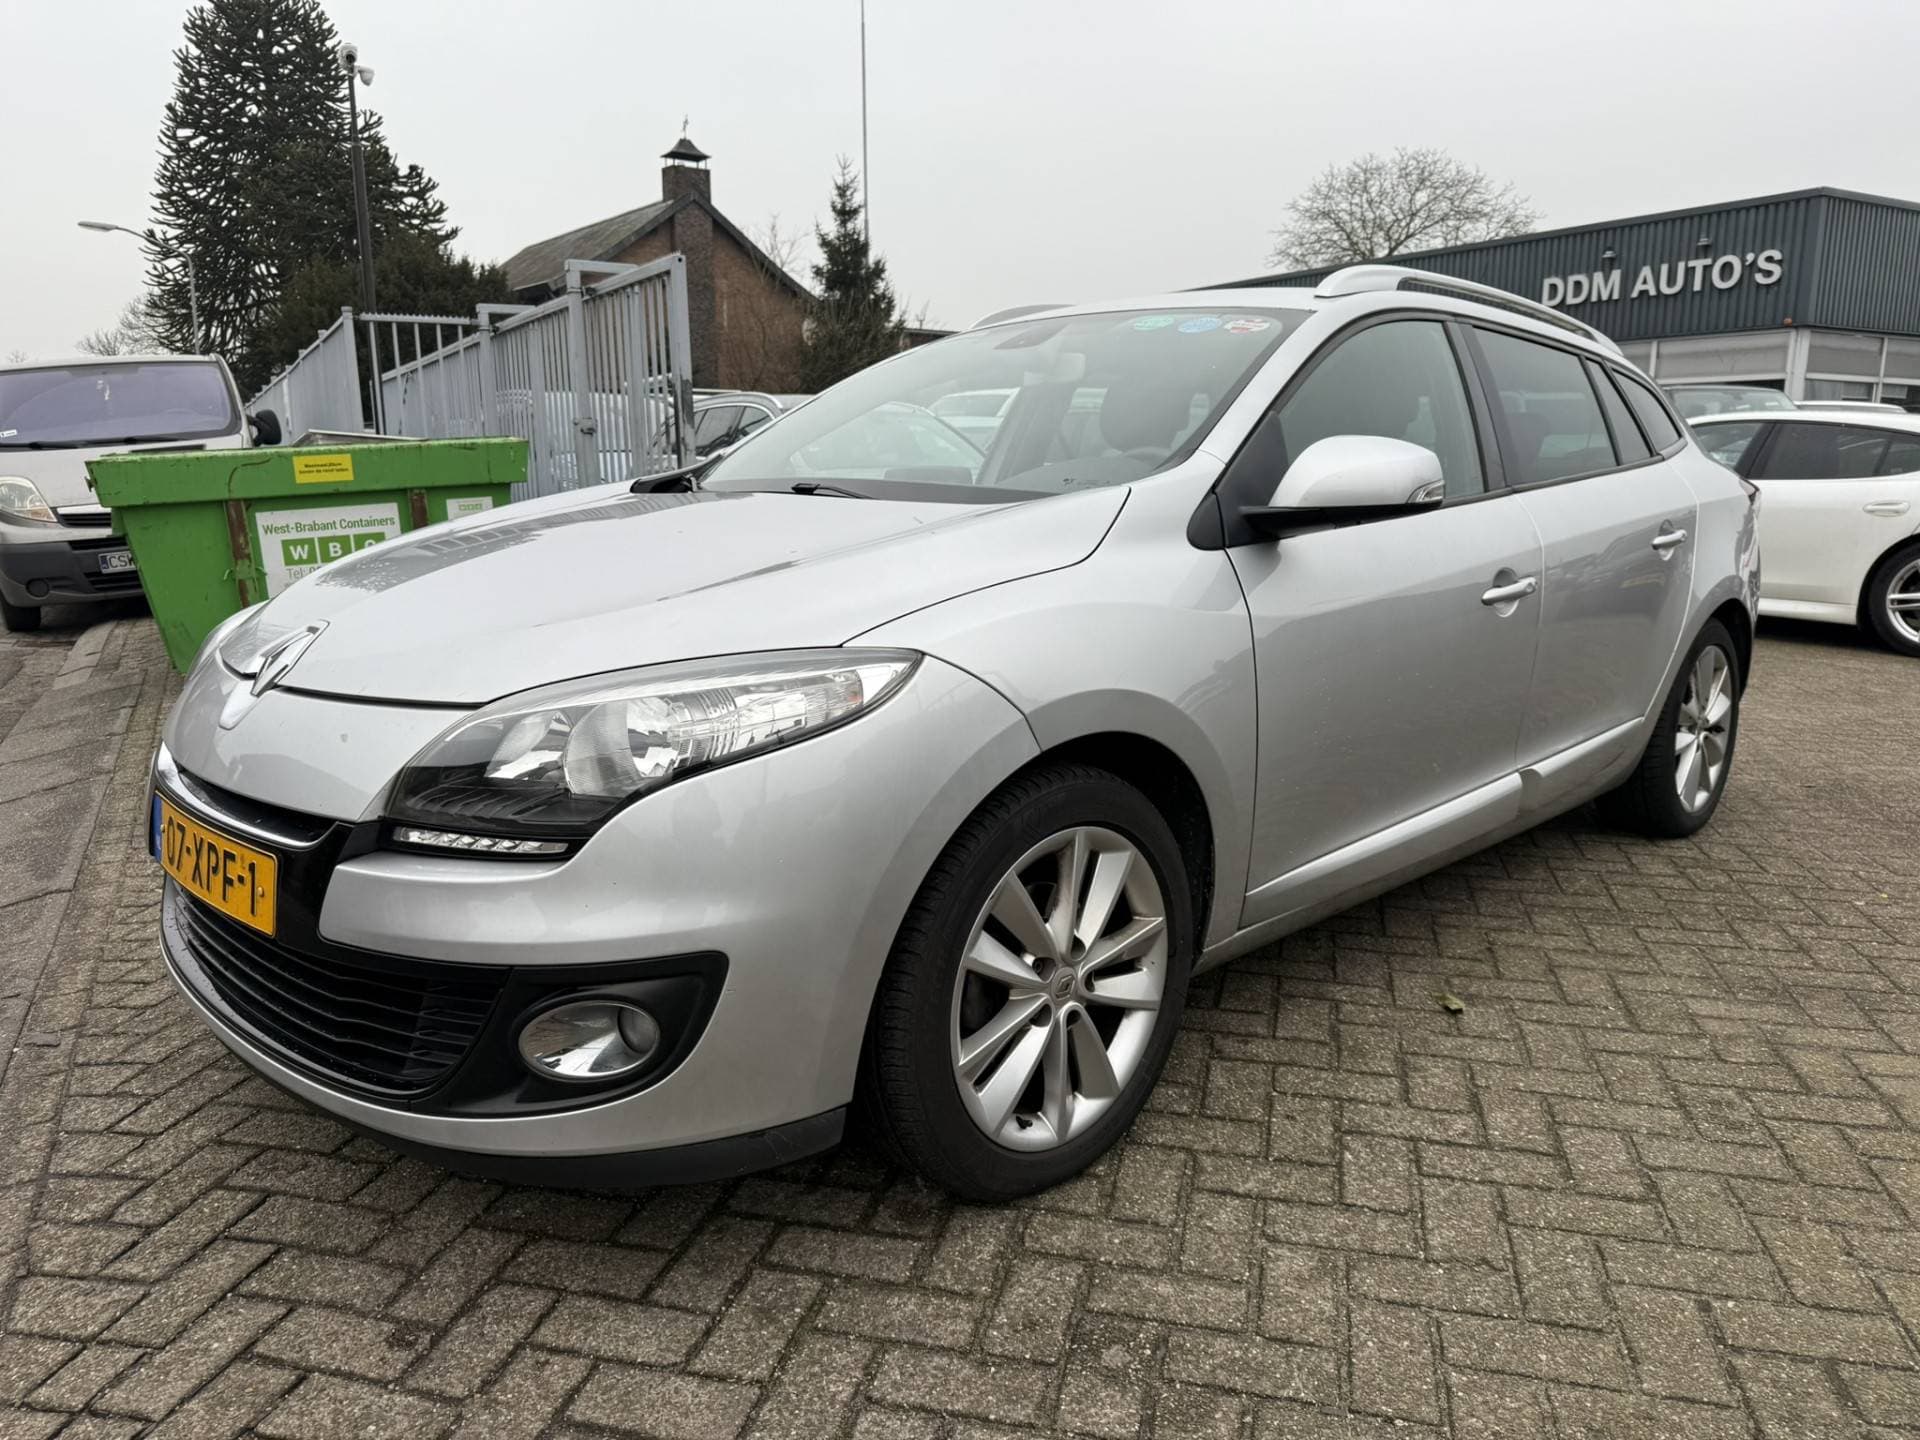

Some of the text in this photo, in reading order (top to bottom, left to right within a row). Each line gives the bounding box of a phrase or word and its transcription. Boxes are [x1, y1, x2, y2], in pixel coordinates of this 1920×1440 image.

[1541, 249, 1783, 307] DDM AUTO'S
[262, 515, 396, 535] West-Brabant Containers
[166, 815, 257, 917] 07-XPF-1
